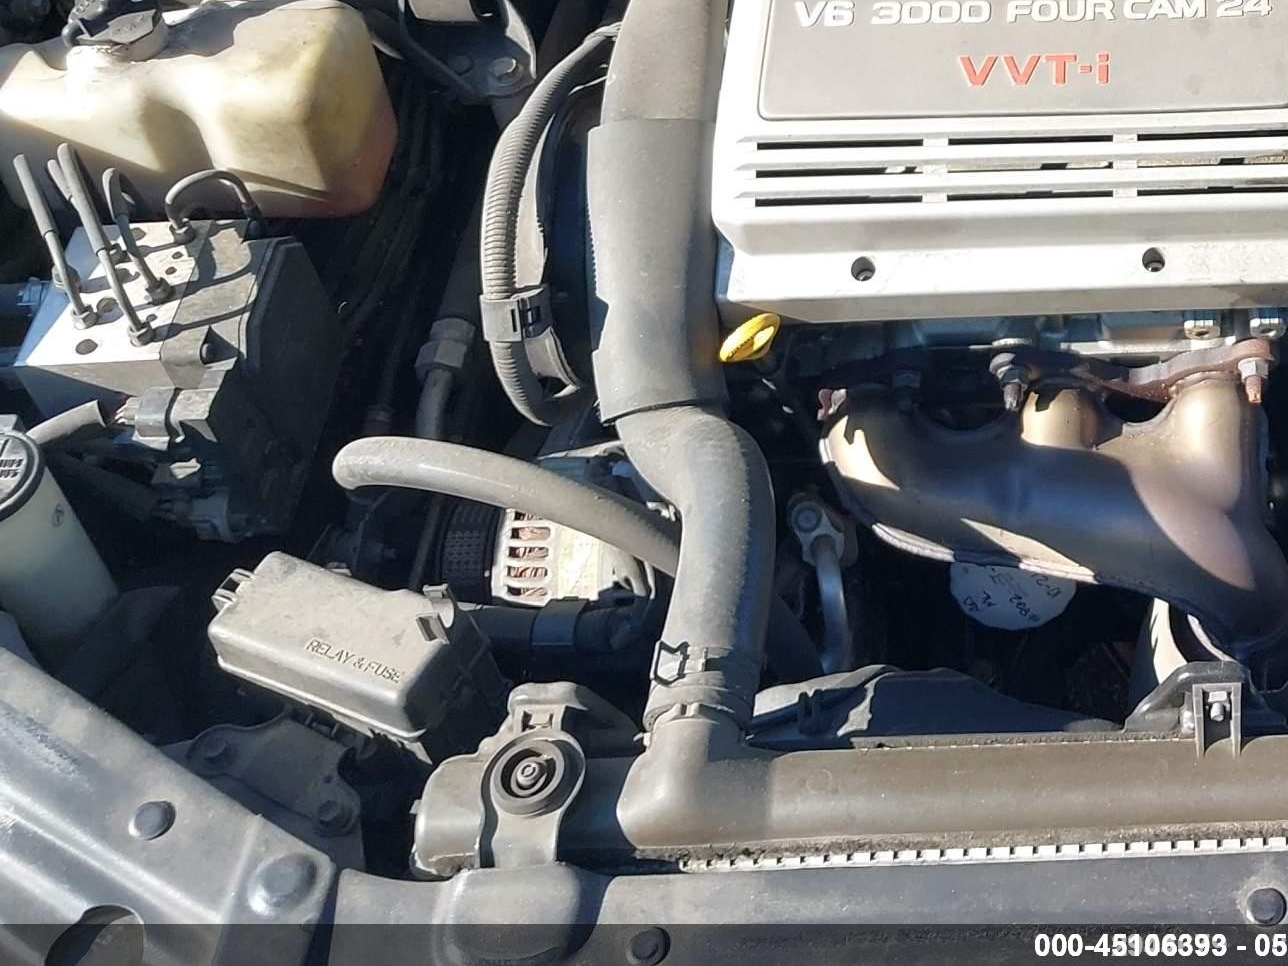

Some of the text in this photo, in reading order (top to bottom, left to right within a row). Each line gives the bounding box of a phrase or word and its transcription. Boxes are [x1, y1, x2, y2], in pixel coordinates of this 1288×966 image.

[794, 0, 856, 28] V6
[870, 0, 992, 26] 3000
[958, 51, 1112, 87] VVT-i
[305, 638, 401, 684] RELAY & FUSE
